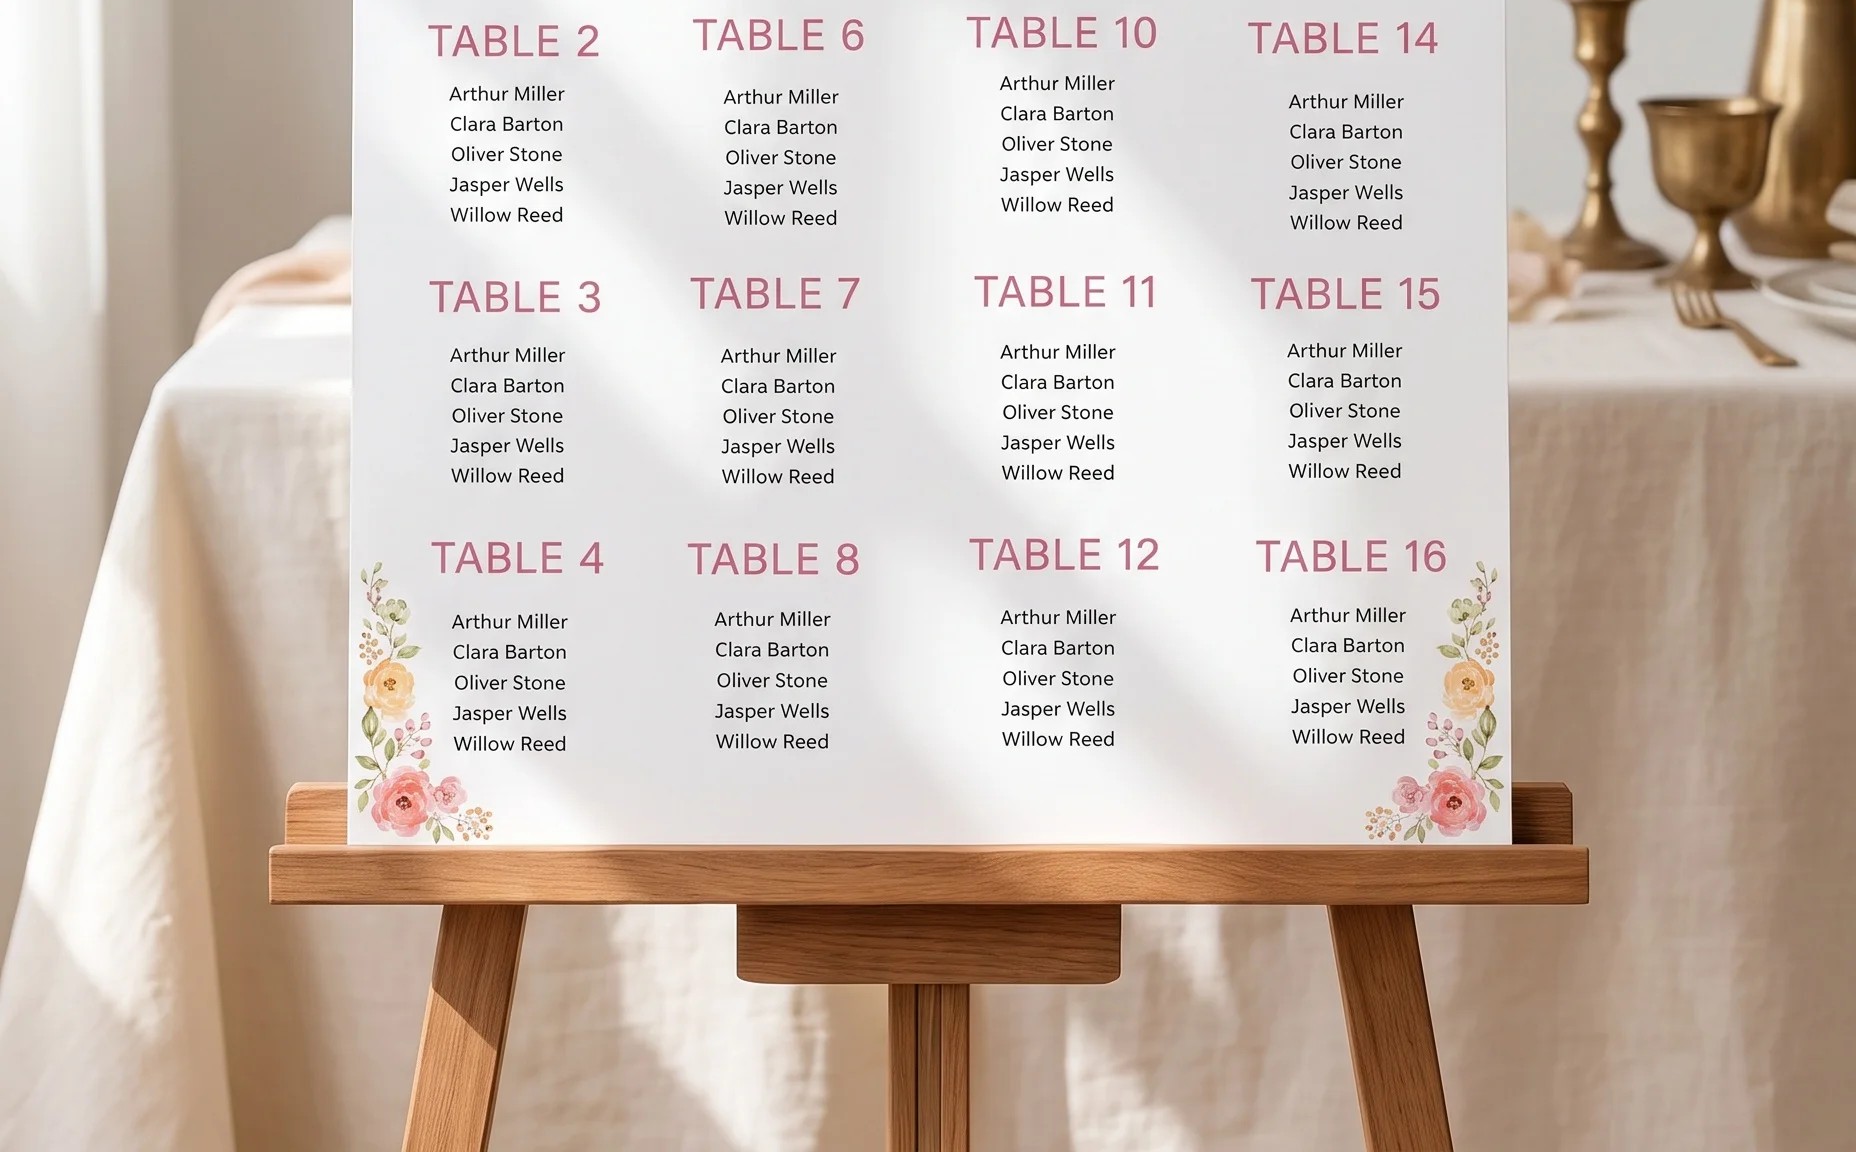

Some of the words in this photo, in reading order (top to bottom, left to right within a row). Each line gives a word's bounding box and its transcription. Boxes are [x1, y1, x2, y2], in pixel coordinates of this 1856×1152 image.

[427, 24, 560, 57] TABLE
[577, 24, 599, 57] 2
[692, 18, 825, 51] TABLE
[841, 18, 864, 52] 6
[966, 16, 1098, 49] TABLE
[1115, 16, 1157, 49] 10
[1247, 21, 1379, 55] TABLE
[1396, 21, 1439, 54] 14
[999, 74, 1060, 92] Arthur
[1064, 74, 1116, 92] Miller
[448, 85, 510, 102] Arthur
[514, 85, 566, 102] Miller
[723, 88, 784, 105] Arthur
[788, 88, 840, 105] Miller
[1288, 92, 1349, 110] Arthur
[1353, 92, 1405, 110] Miller
[724, 118, 771, 136] Clara
[776, 119, 838, 136] Barton
[1289, 123, 1337, 140] Clara
[1342, 123, 1403, 140] Barton
[1001, 135, 1056, 152] Oliver
[1059, 135, 1113, 152] Stone
[725, 148, 779, 166] Oliver
[783, 149, 837, 166] Stone
[999, 166, 1061, 187] Jasper
[1065, 165, 1115, 183] Wells
[449, 176, 511, 197] Jasper
[514, 175, 564, 193] Wells
[1000, 195, 1063, 213] Willow
[1068, 195, 1114, 213] Reed
[449, 206, 512, 223] Willow
[517, 206, 563, 223] Reed
[1289, 213, 1352, 231] Willow
[1357, 213, 1403, 231] Reed
[429, 280, 561, 313] TABLE
[578, 280, 601, 314] 3
[690, 277, 822, 310] TABLE
[837, 277, 861, 310] 7
[974, 275, 1106, 308] TABLE
[1122, 275, 1154, 308] 11
[1250, 277, 1382, 310] TABLE
[1399, 277, 1440, 311] 15
[720, 347, 781, 364] Arthur
[786, 347, 838, 364] Miller
[999, 343, 1061, 360] Arthur
[1065, 343, 1117, 360] Miller
[450, 376, 498, 394] Clara
[503, 377, 565, 394] Barton
[721, 377, 768, 394] Clara
[773, 378, 835, 395] Barton
[1001, 373, 1048, 390] Clara
[1053, 374, 1115, 390] Barton
[451, 407, 506, 424] Oliver
[510, 407, 564, 424] Stone
[1002, 403, 1057, 421] Oliver
[1060, 404, 1114, 421] Stone
[1289, 401, 1343, 419] Oliver
[1347, 402, 1401, 419] Stone
[450, 437, 512, 458] Jasper
[515, 436, 565, 454] Wells
[720, 438, 783, 459] Jasper
[786, 437, 836, 455] Wells
[1287, 432, 1349, 453] Jasper
[1352, 431, 1402, 449] Wells
[721, 467, 784, 485] Willow
[789, 467, 835, 485] Reed
[1288, 462, 1350, 479] Willow
[1355, 462, 1402, 480] Reed
[431, 541, 563, 574] TABLE
[579, 541, 604, 574] 4
[687, 542, 819, 576] TABLE
[836, 542, 859, 576] 8
[968, 538, 1101, 571] TABLE
[1118, 537, 1159, 571] 12
[1255, 539, 1388, 573] TABLE
[1405, 539, 1447, 573] 16
[451, 612, 512, 630] Arthur
[517, 612, 569, 630] Miller
[999, 608, 1061, 626] Arthur
[1066, 608, 1117, 626] Miller
[1289, 606, 1351, 624] Arthur
[1355, 606, 1407, 624] Miller
[452, 643, 499, 660] Clara
[505, 643, 567, 660] Barton
[715, 641, 762, 658] Clara
[767, 641, 829, 658] Barton
[1291, 636, 1338, 654] Clara
[1343, 637, 1405, 654] Barton
[454, 673, 508, 691] Oliver
[512, 674, 566, 691] Stone
[716, 671, 771, 689] Oliver
[775, 672, 828, 689] Stone
[1292, 667, 1347, 684] Oliver
[1351, 667, 1404, 684] Stone
[714, 703, 776, 723] Jasper
[780, 702, 830, 719] Wells
[1000, 700, 1062, 721] Jasper
[1066, 699, 1116, 717] Wells
[1290, 698, 1352, 718] Jasper
[1356, 697, 1406, 715] Wells
[453, 735, 516, 752] Willow
[521, 735, 566, 752] Reed
[1001, 730, 1064, 747] Willow
[1069, 730, 1115, 747] Reed
